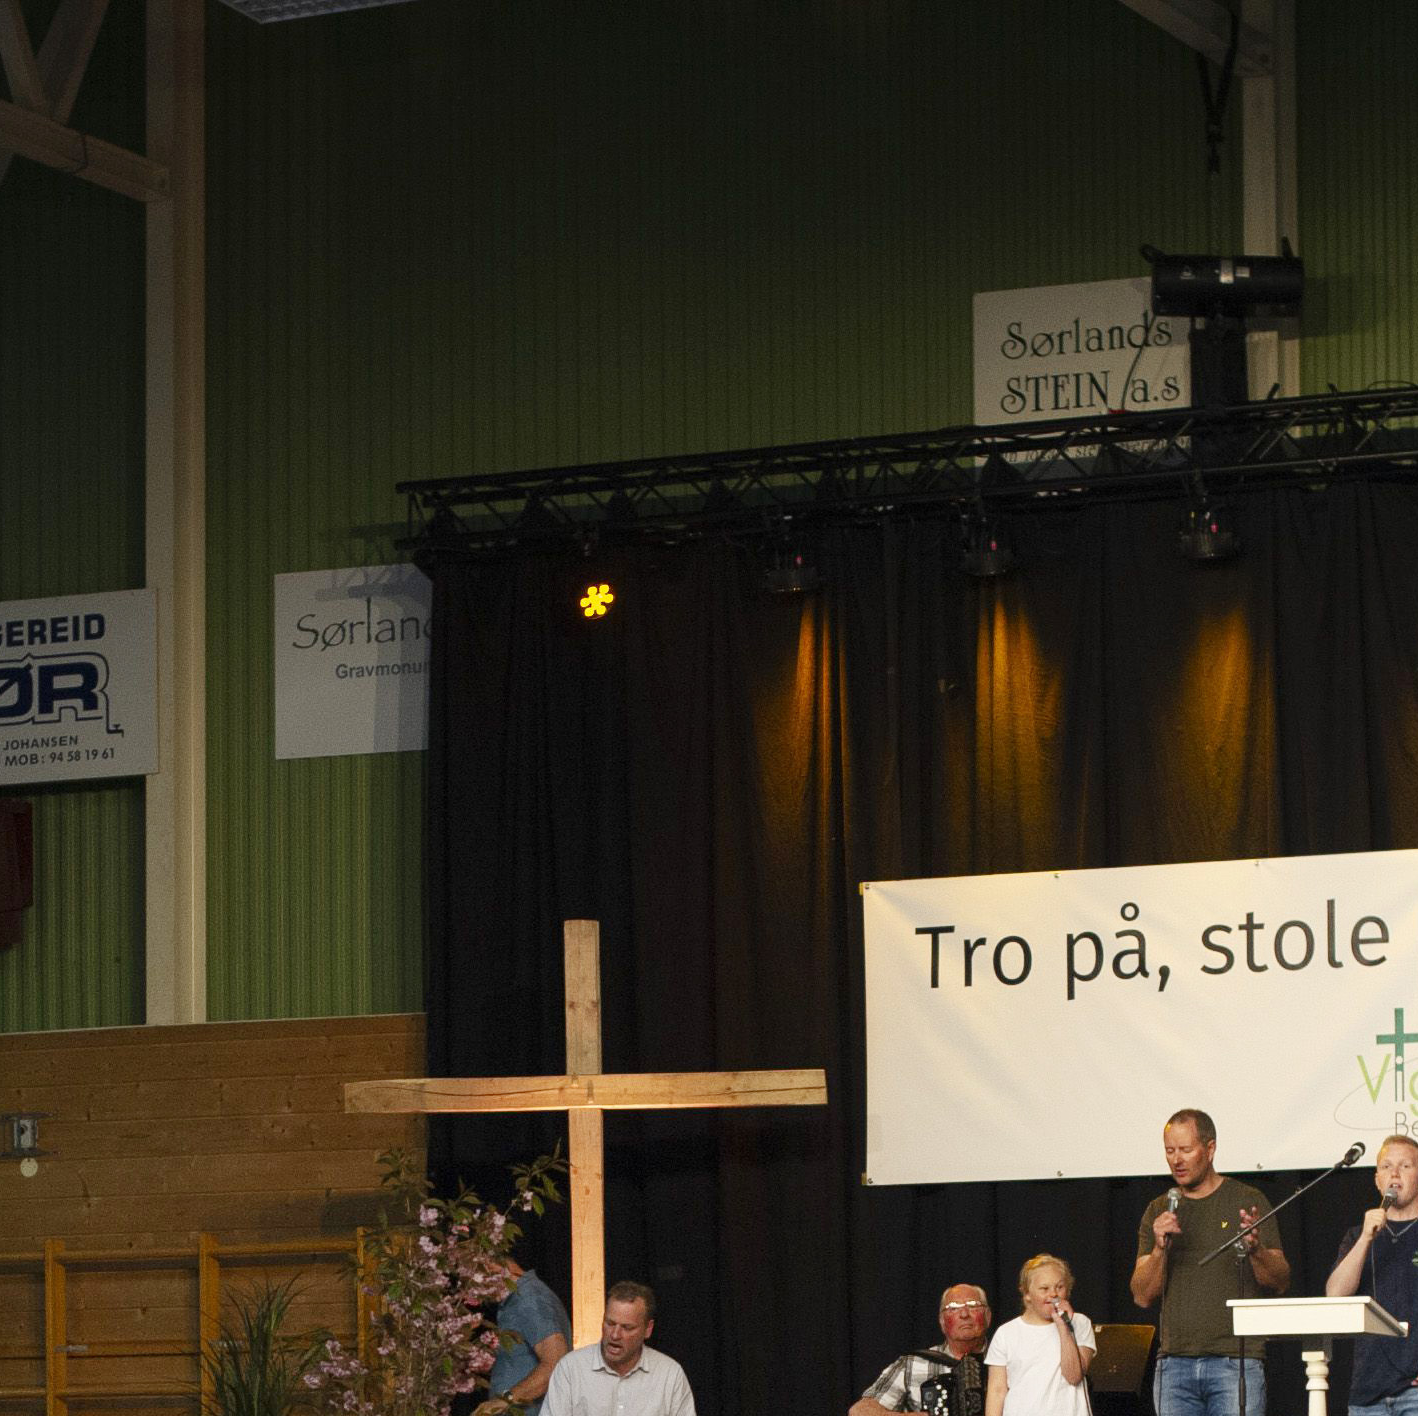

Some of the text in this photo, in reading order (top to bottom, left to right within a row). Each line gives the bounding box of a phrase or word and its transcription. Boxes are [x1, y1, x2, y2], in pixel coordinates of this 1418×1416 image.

[1000, 309, 1173, 360] Sørlands
[1000, 370, 1181, 415] STEIN a.s
[292, 597, 431, 652] Sørlan
[335, 661, 430, 679] Gravmonu
[3, 735, 78, 752] JOHANSEN
[4, 753, 45, 767] MOB:
[50, 751, 63, 763] 94
[67, 750, 81, 762] 58
[85, 748, 98, 760] 19
[101, 747, 115, 759] 61
[915, 926, 1032, 990] Tro
[1066, 901, 1173, 999] på,
[1201, 898, 1390, 974] stole
